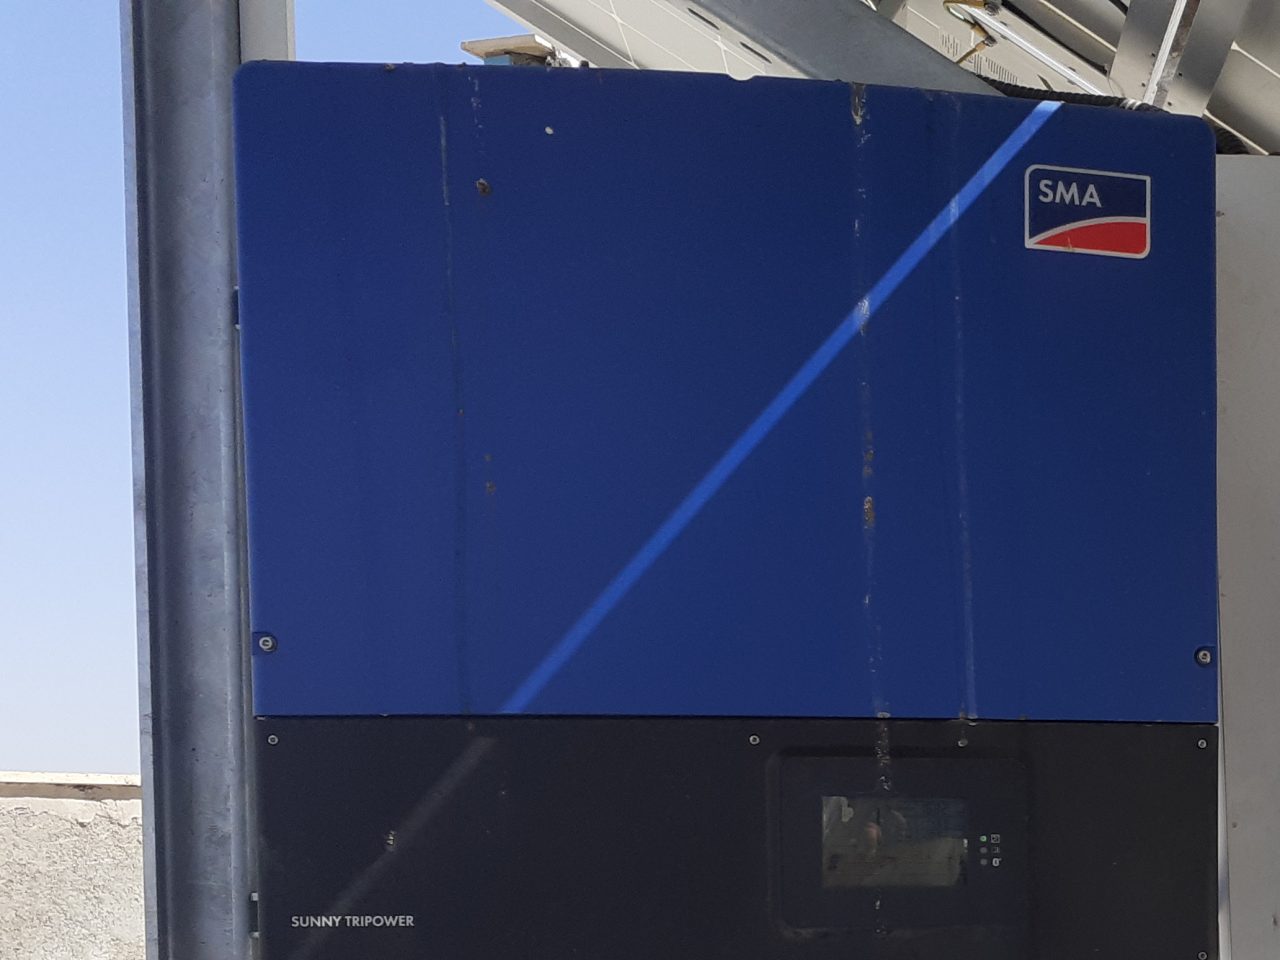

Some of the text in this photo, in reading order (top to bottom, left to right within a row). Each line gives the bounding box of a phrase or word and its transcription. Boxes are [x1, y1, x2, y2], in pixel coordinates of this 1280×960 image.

[1038, 179, 1102, 208] SMA
[291, 915, 415, 928] SUNNY TRIPOWER
